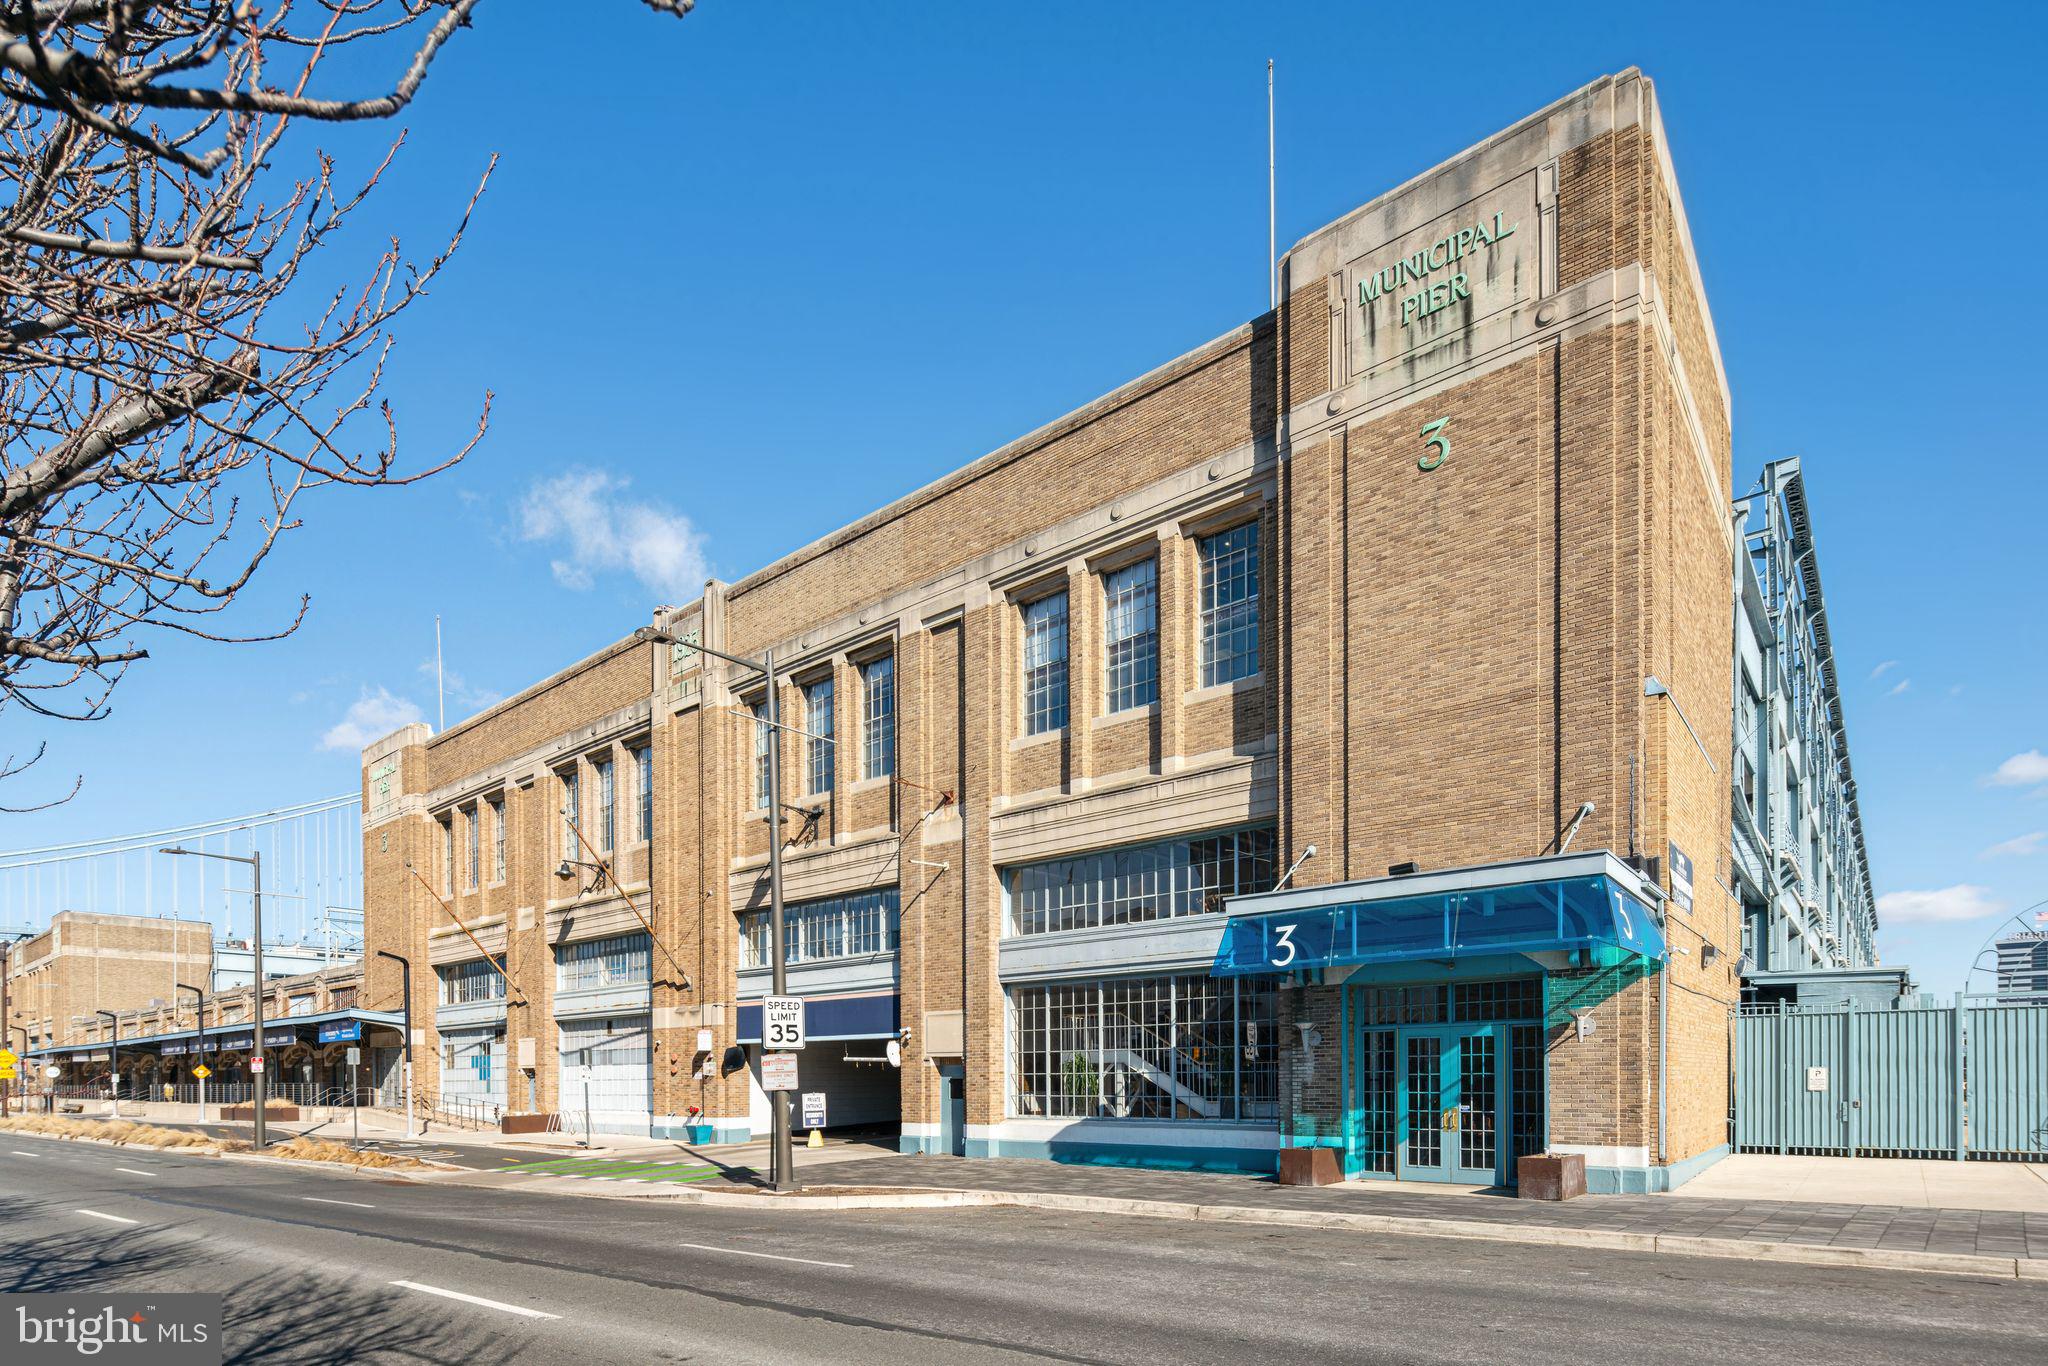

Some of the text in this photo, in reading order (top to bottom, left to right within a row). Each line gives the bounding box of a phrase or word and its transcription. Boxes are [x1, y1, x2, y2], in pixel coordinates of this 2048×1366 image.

[1358, 210, 1520, 308] MUNICIPAL
[1401, 272, 1471, 328] PIER
[1418, 415, 1451, 472] 3
[1613, 890, 1633, 940] 3
[1271, 924, 1298, 967] 3
[767, 1001, 801, 1011] SPEED
[770, 1013, 797, 1021] LIMIT
[770, 1024, 799, 1043] 35
